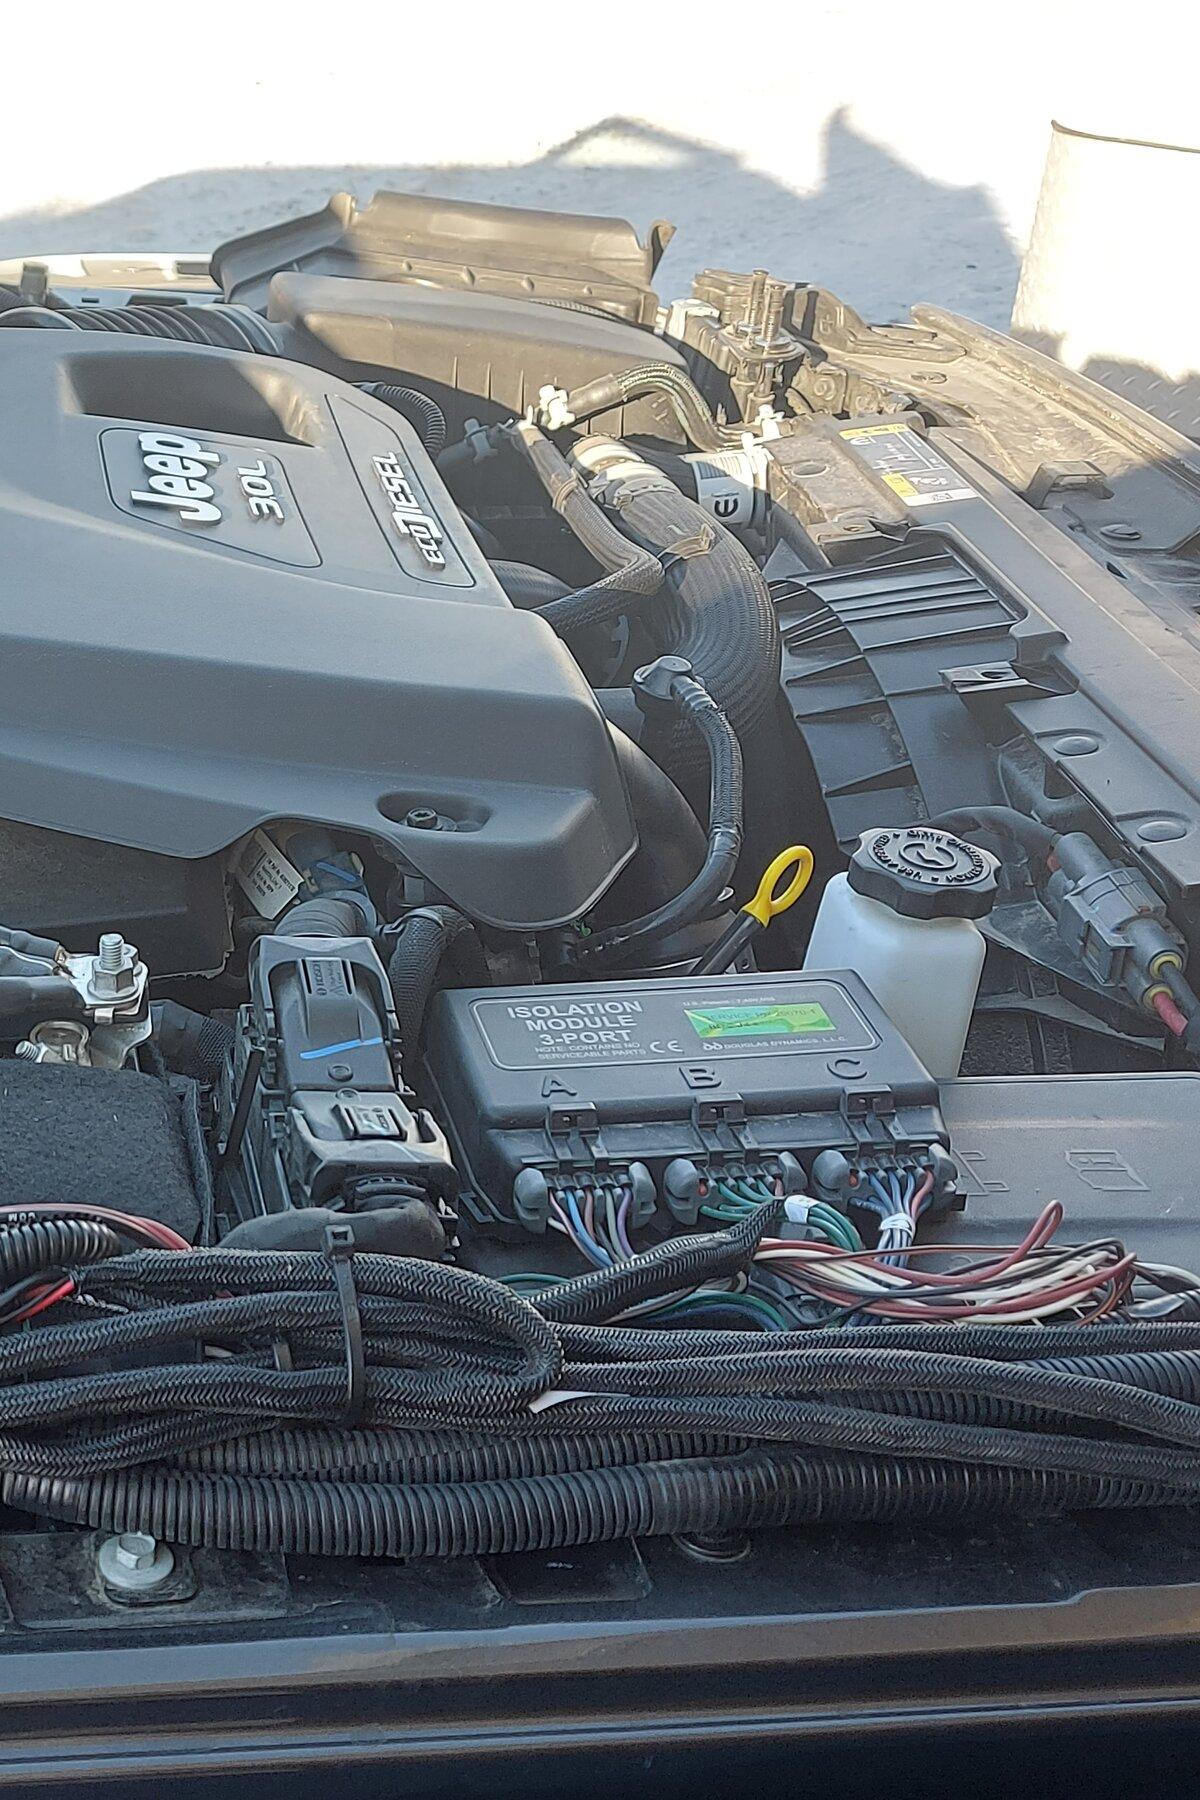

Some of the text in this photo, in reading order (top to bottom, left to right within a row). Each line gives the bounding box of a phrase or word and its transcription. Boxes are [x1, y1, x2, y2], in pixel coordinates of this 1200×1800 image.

[130, 432, 222, 521] Jeep
[371, 451, 442, 537] DIESEL
[507, 1000, 644, 1018] ISOLATION
[525, 1014, 638, 1032] MODULE
[538, 1029, 633, 1045] 3-PORT
[679, 1065, 721, 1089] B
[826, 1058, 868, 1080] C
[541, 1073, 578, 1097] A
